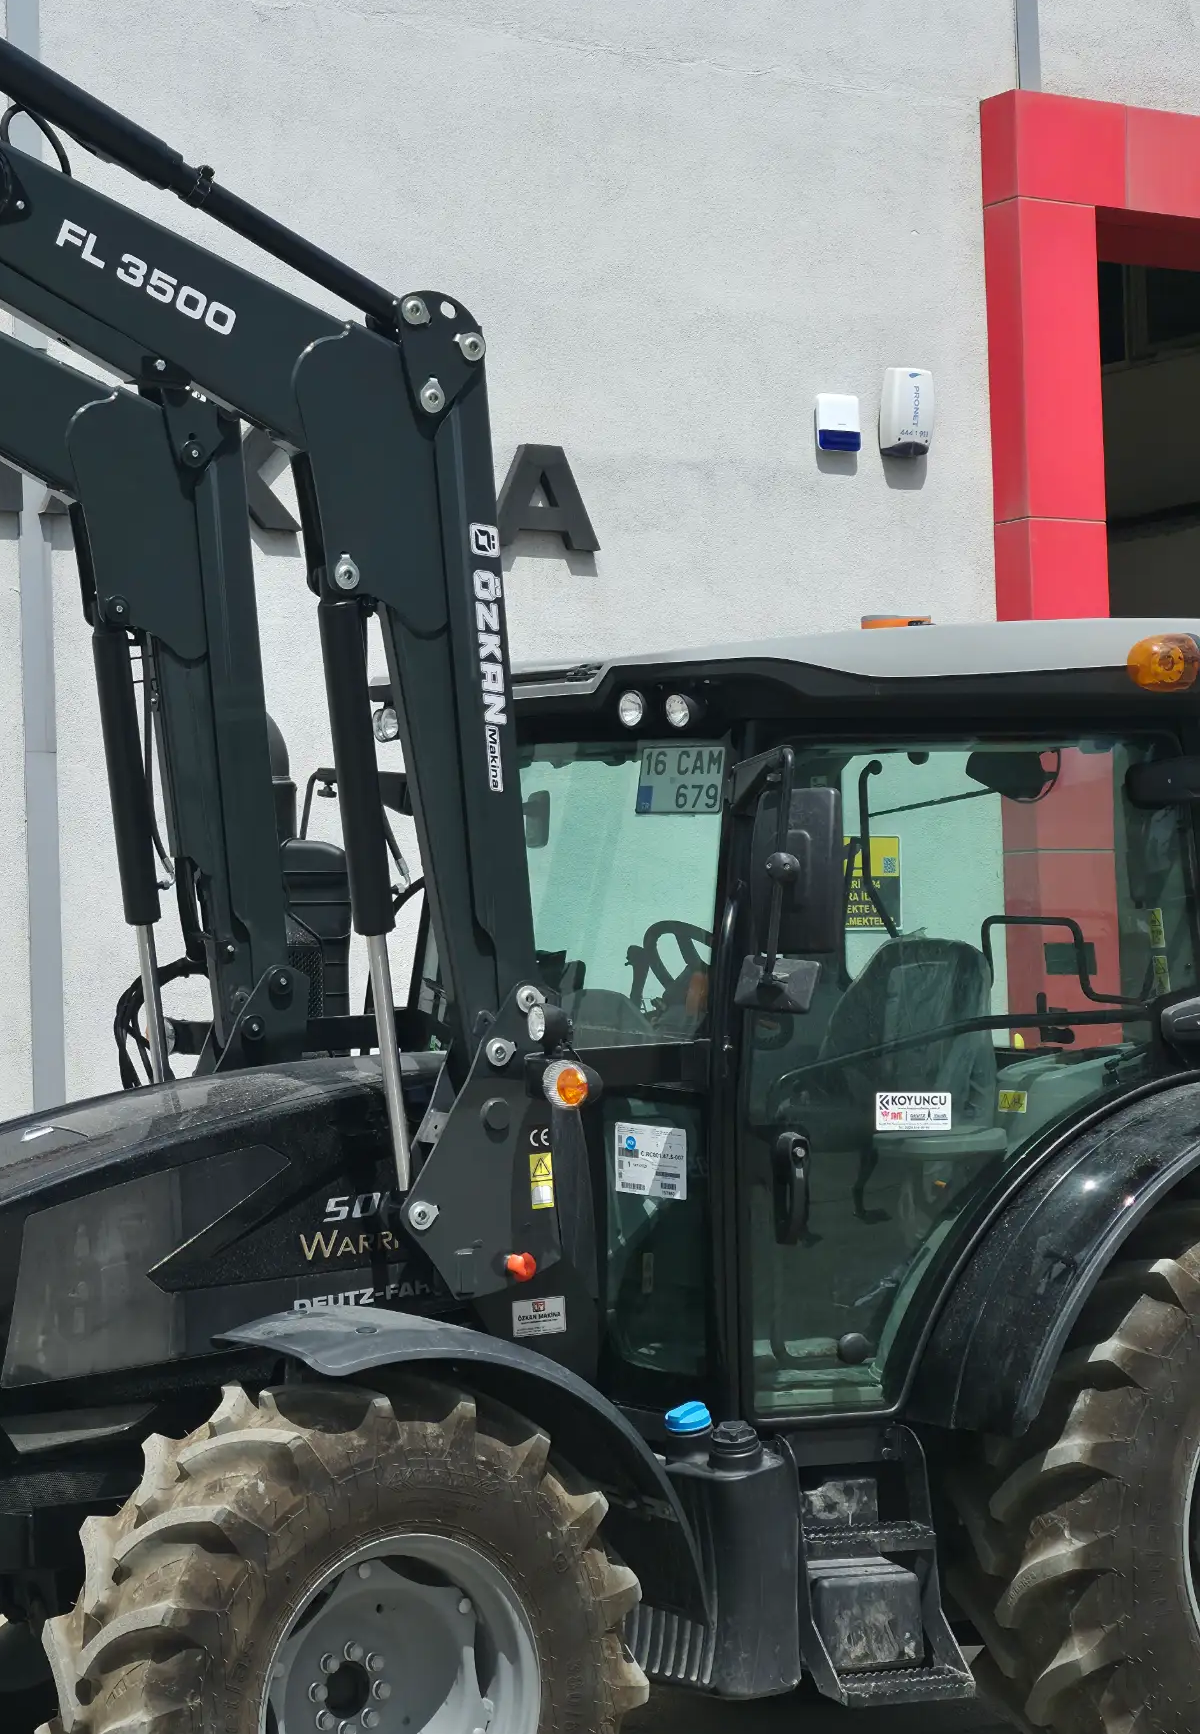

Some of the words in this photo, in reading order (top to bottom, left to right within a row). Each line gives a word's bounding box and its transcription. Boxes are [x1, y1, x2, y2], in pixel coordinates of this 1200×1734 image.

[55, 218, 106, 270] FL
[116, 252, 237, 336] 3500
[912, 385, 920, 427] PRONET
[472, 568, 508, 726] ÖZKAN
[486, 726, 502, 791] Makina
[646, 750, 668, 776] 16
[677, 750, 723, 776] CAM
[675, 783, 719, 809] 679
[891, 1095, 947, 1106] KOYUNCU
[529, 1128, 550, 1147] CE
